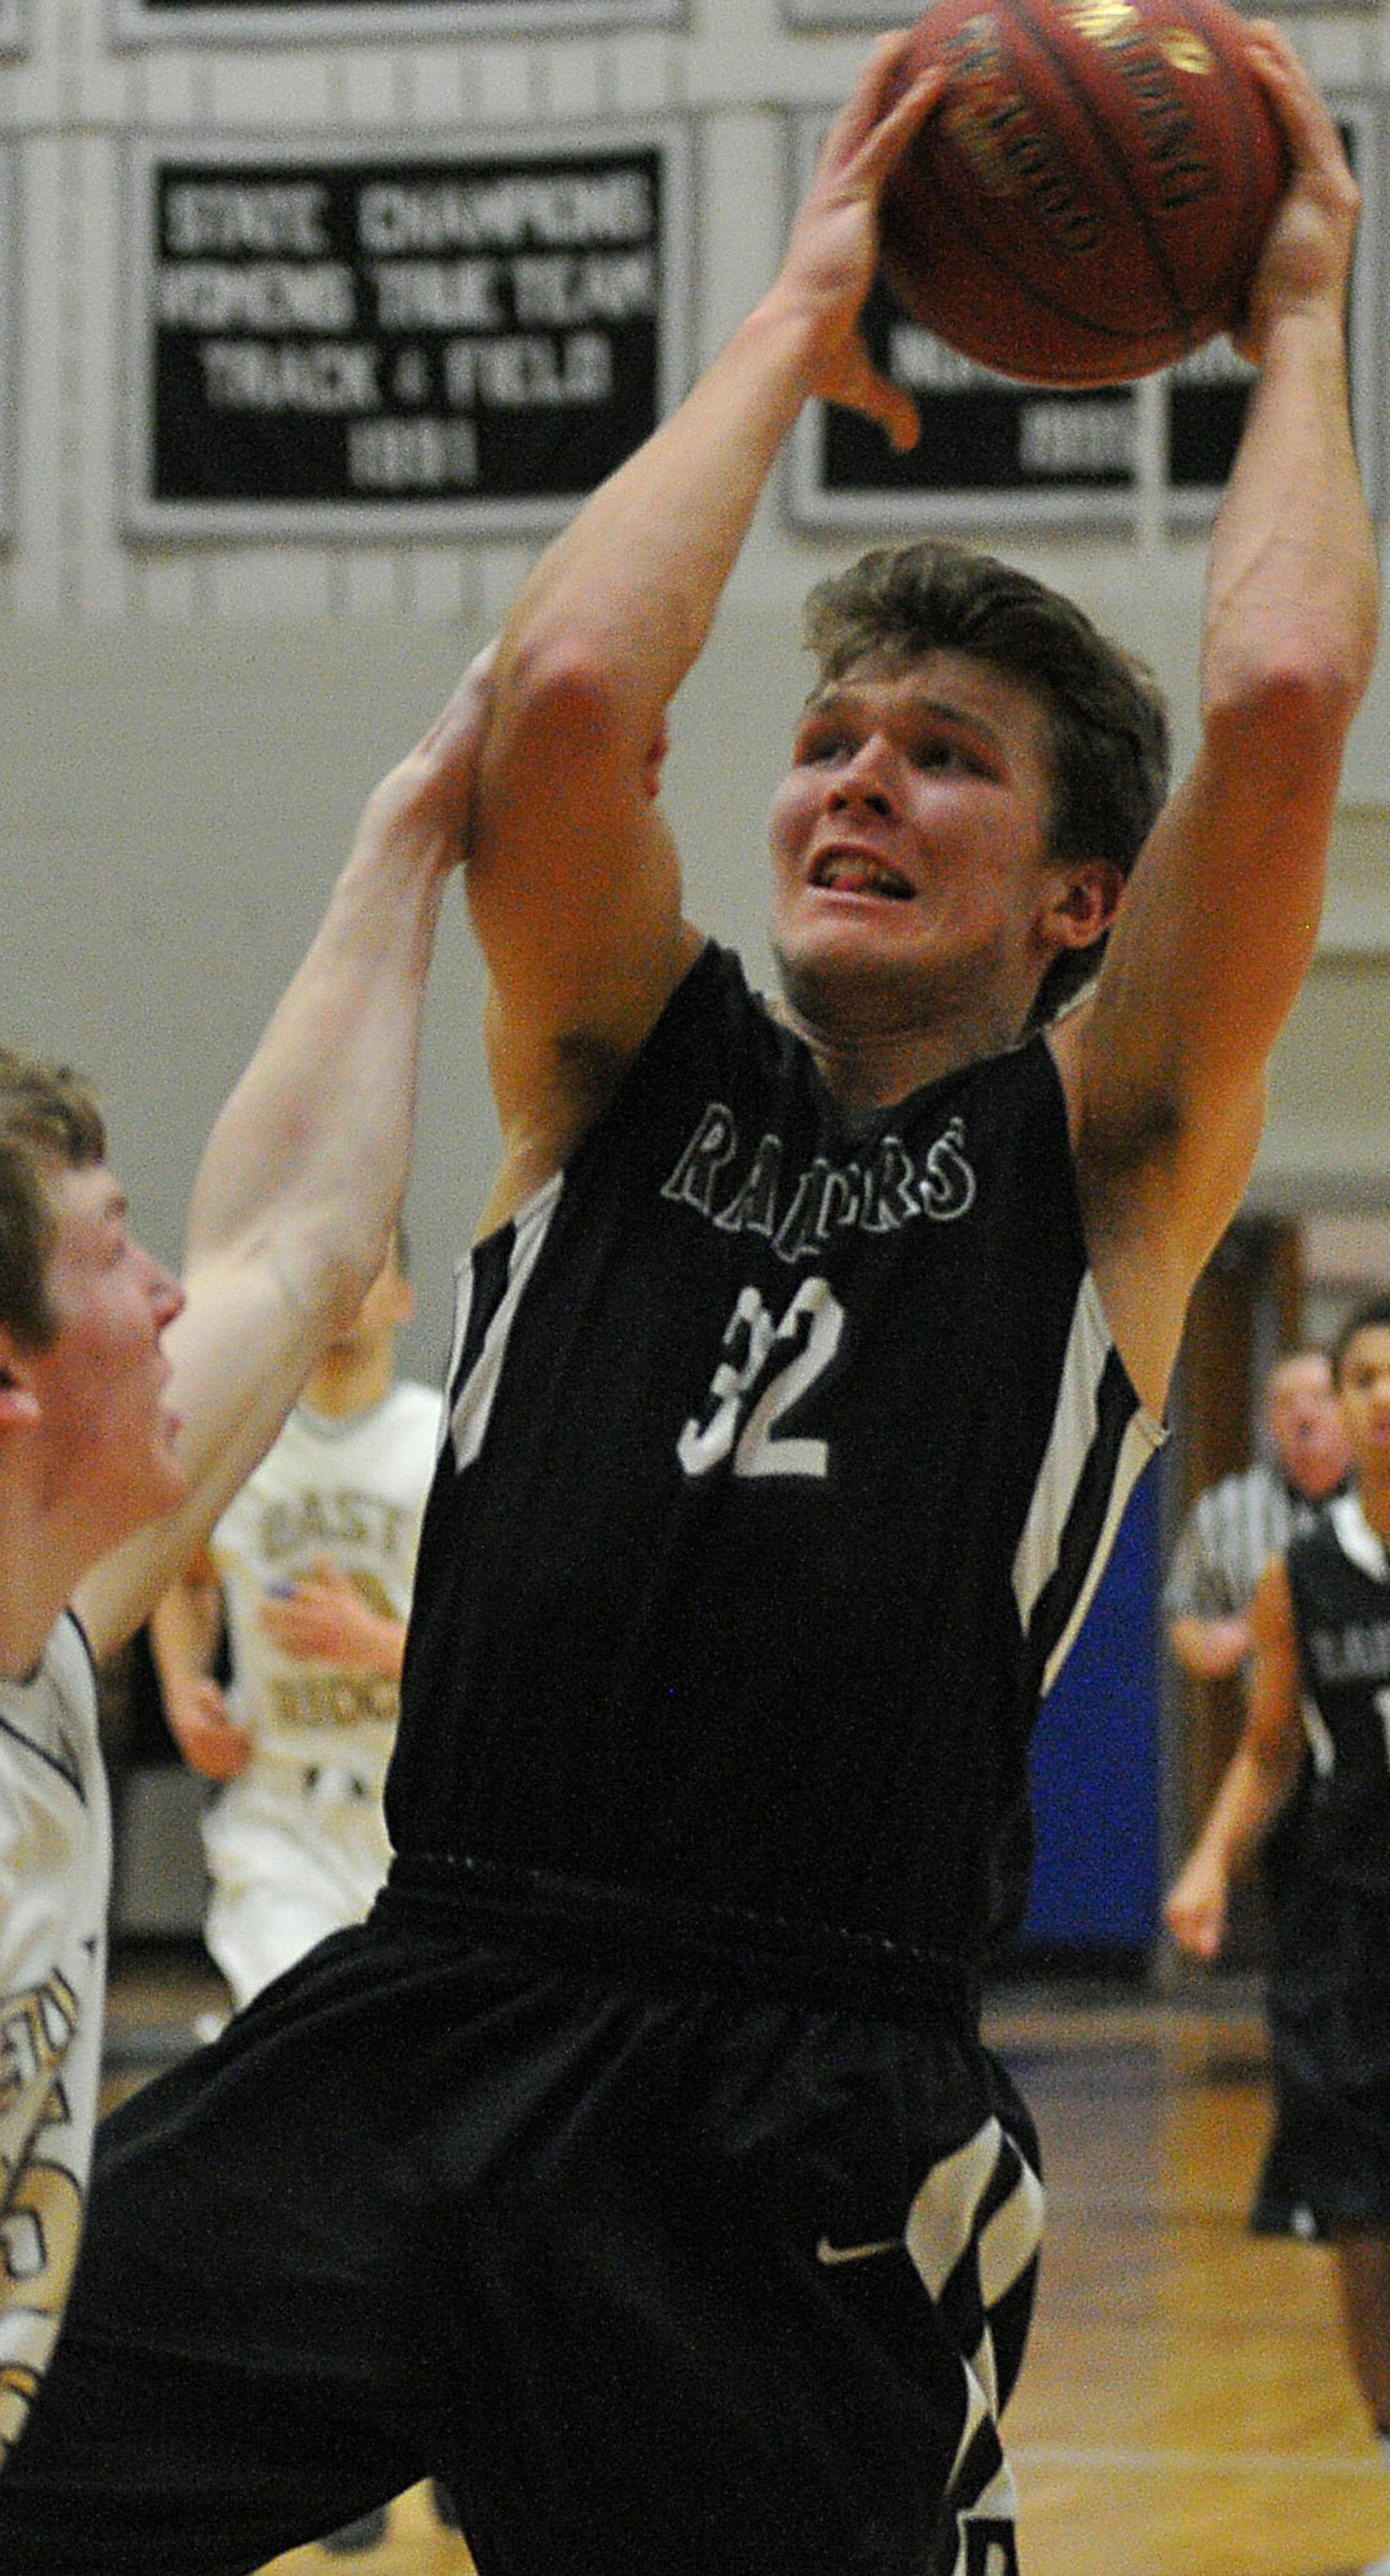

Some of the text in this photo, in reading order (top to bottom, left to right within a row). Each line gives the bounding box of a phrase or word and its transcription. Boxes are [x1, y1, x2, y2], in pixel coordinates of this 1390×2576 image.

[199, 340, 382, 414] TRACK
[445, 330, 613, 409] FIELD
[677, 1276, 844, 1478] 32
